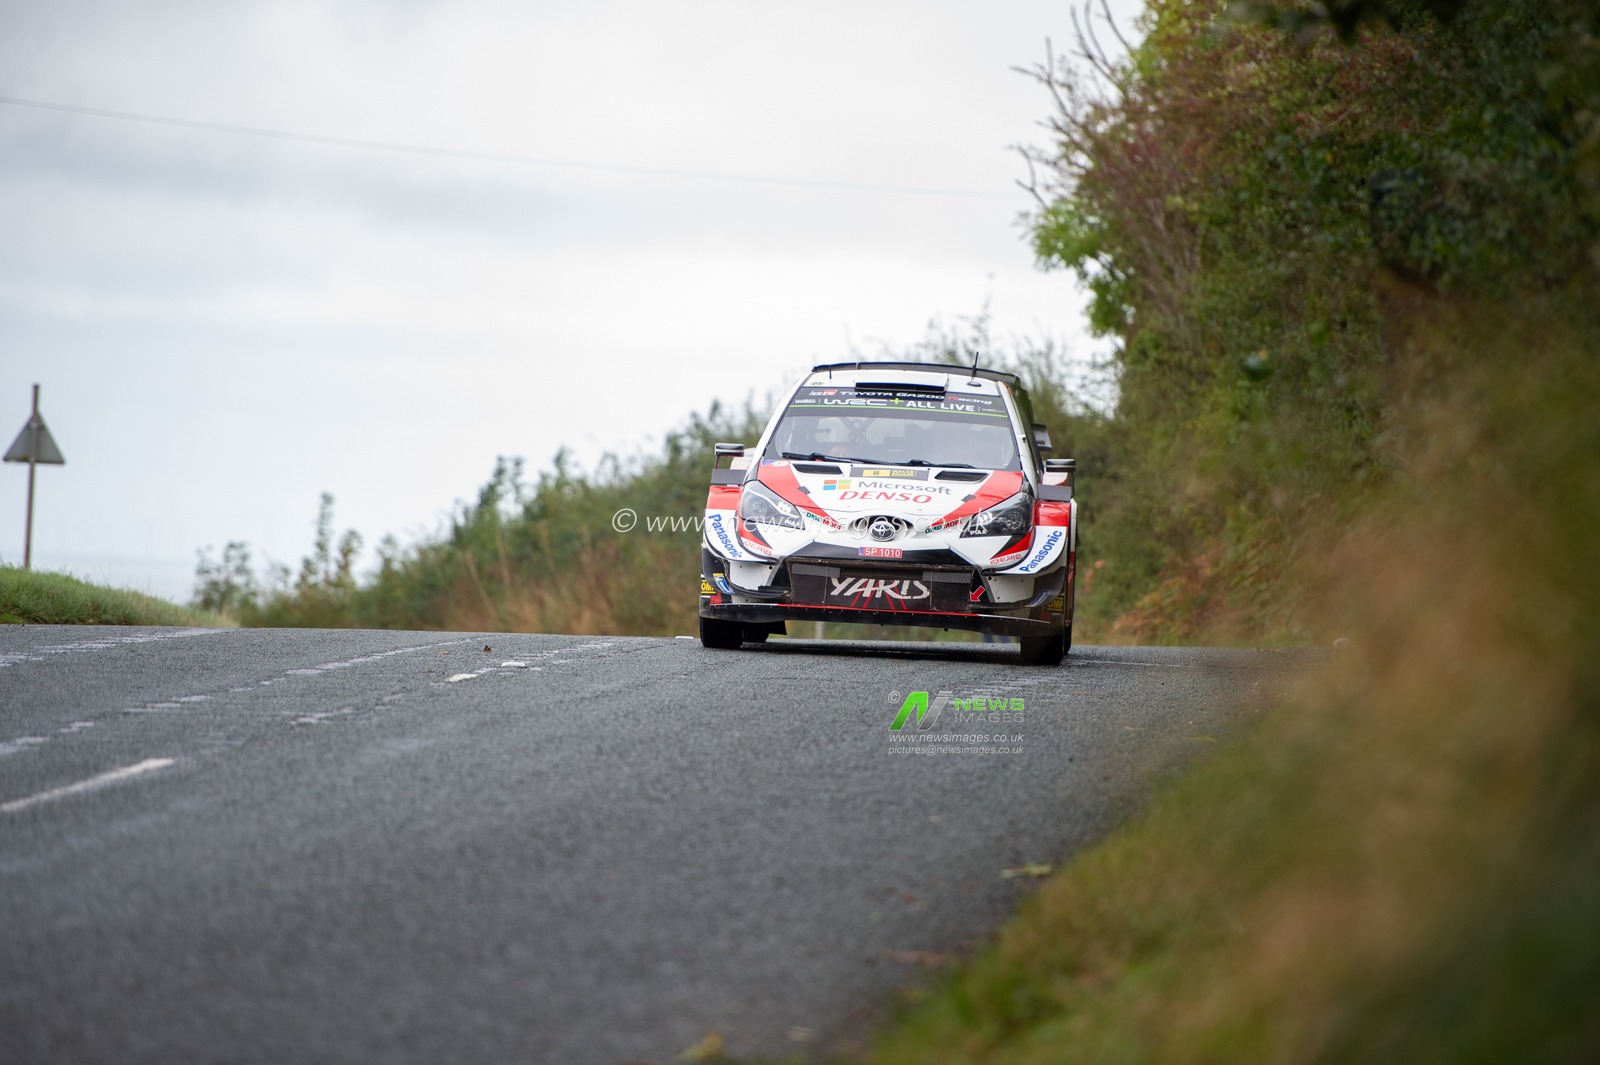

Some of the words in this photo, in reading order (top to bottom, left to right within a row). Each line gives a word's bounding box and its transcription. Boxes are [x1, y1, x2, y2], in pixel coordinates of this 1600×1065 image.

[896, 392, 945, 400] GAZOO
[906, 400, 936, 409] ALL
[940, 402, 975, 412] LIVE
[858, 481, 953, 496] Microsoft
[839, 490, 932, 504] DENSO
[708, 513, 742, 558] Panasonic
[864, 547, 877, 556] SP
[880, 548, 901, 557] 1010
[1019, 530, 1063, 572] Panasonic
[830, 577, 931, 600] YARIS
